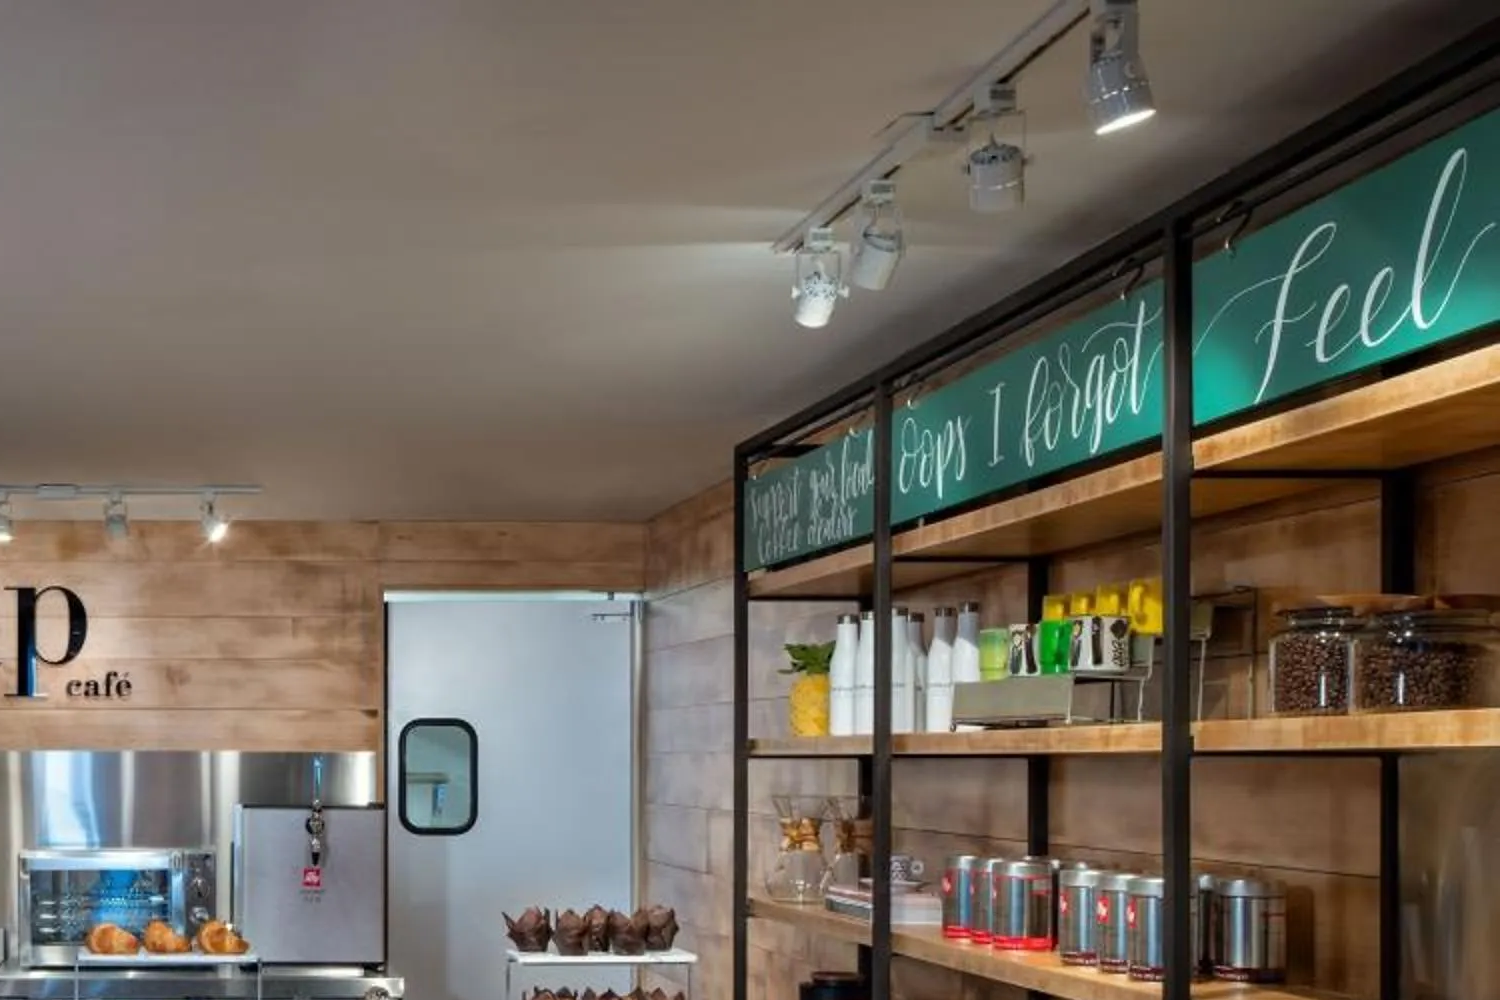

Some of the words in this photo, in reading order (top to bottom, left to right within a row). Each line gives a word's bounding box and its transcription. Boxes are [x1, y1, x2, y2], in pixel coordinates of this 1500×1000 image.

[988, 381, 1005, 468] I
[1020, 300, 1164, 468] forgot
[65, 671, 133, 698] café
